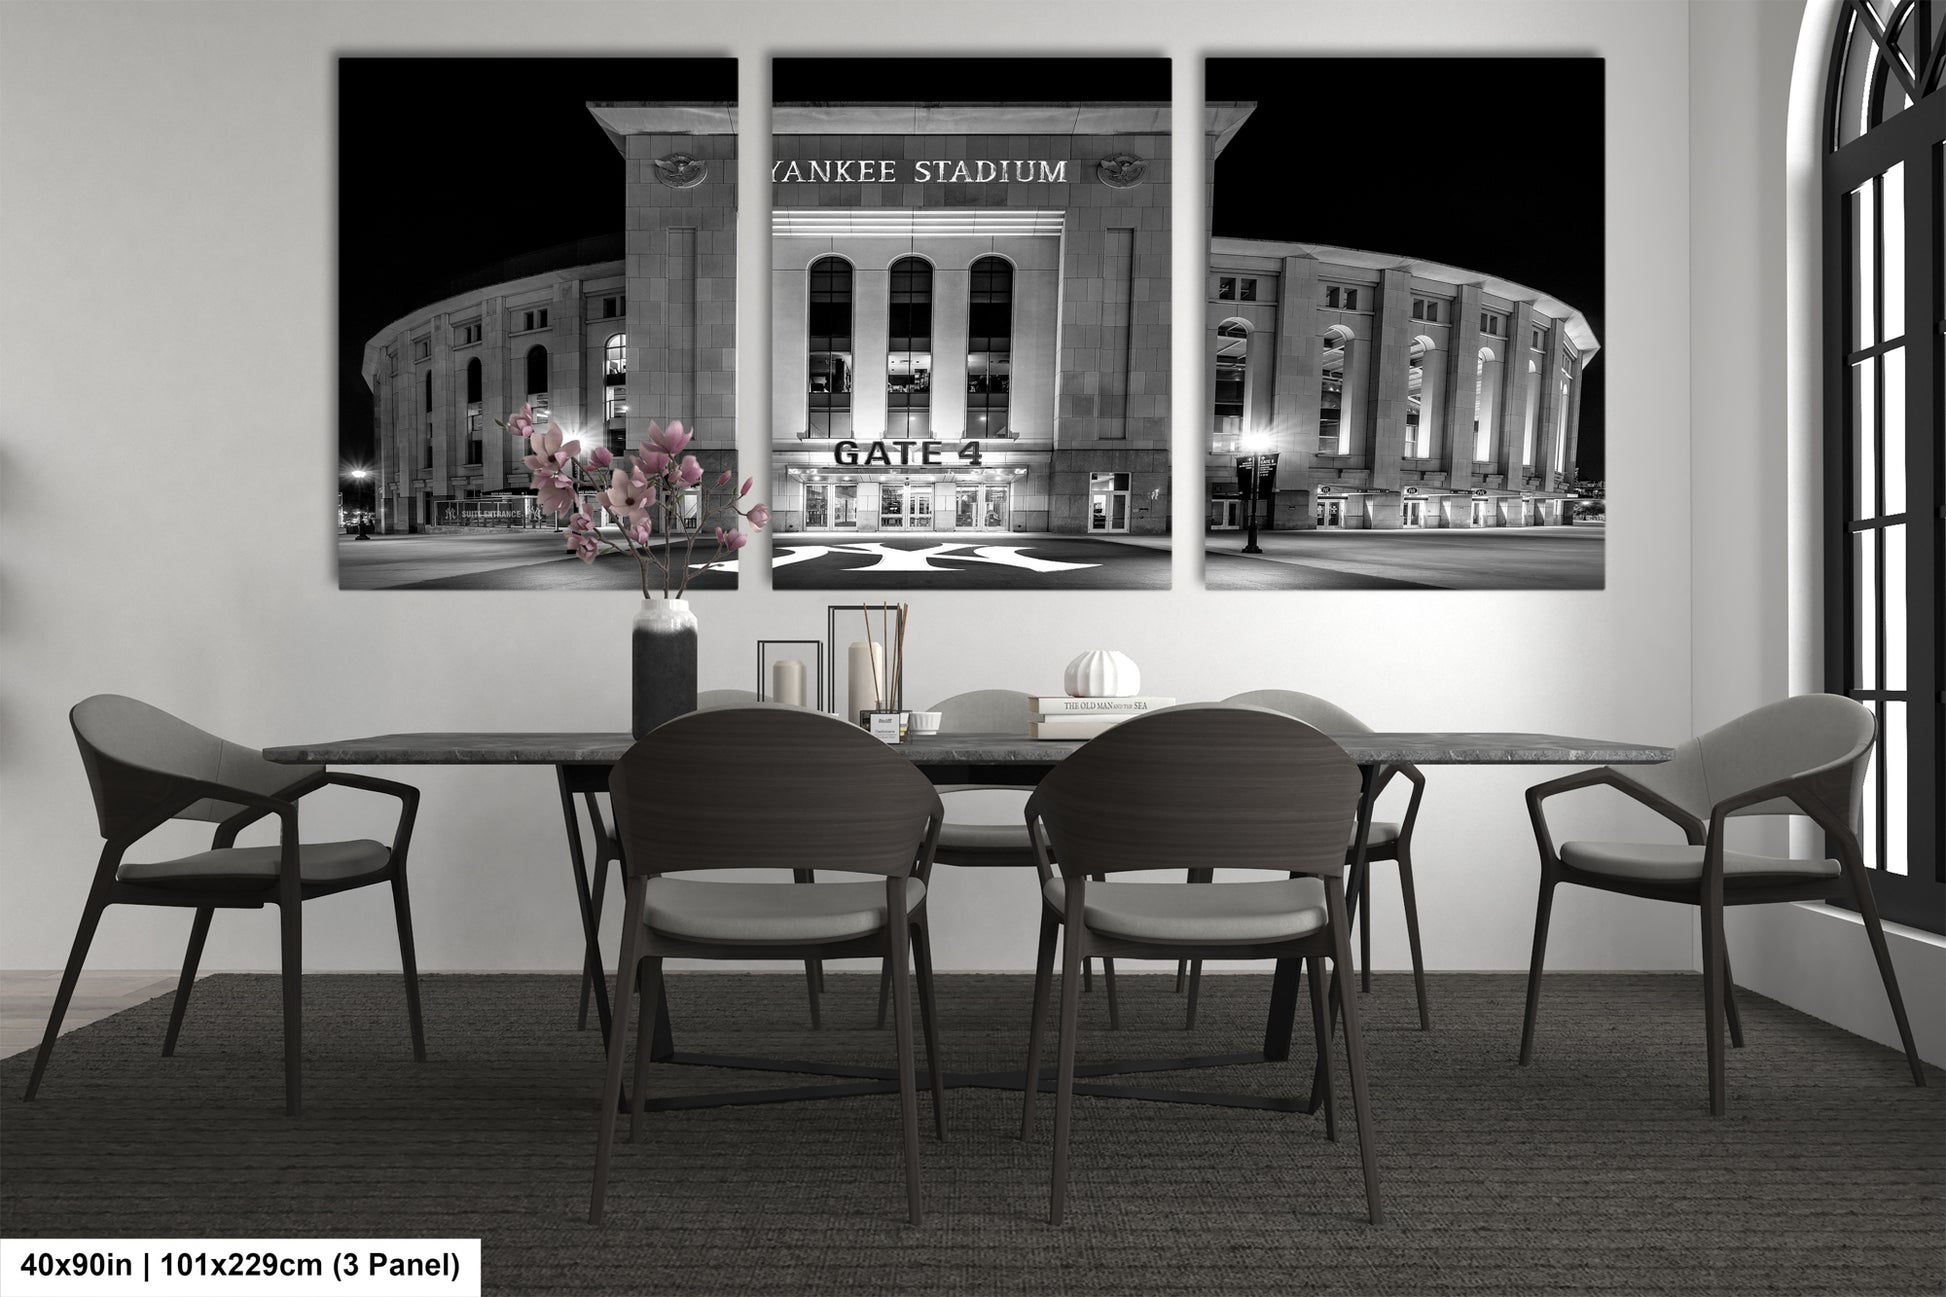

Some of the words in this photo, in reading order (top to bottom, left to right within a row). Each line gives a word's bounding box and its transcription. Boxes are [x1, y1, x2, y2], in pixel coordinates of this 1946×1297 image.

[914, 160, 1068, 183] STADIUM
[834, 440, 942, 466] GATE
[958, 440, 983, 466] 4
[1064, 702, 1079, 710] THE
[1080, 702, 1096, 710] OLD
[1096, 702, 1113, 710] MAN
[1134, 701, 1148, 710] SEA
